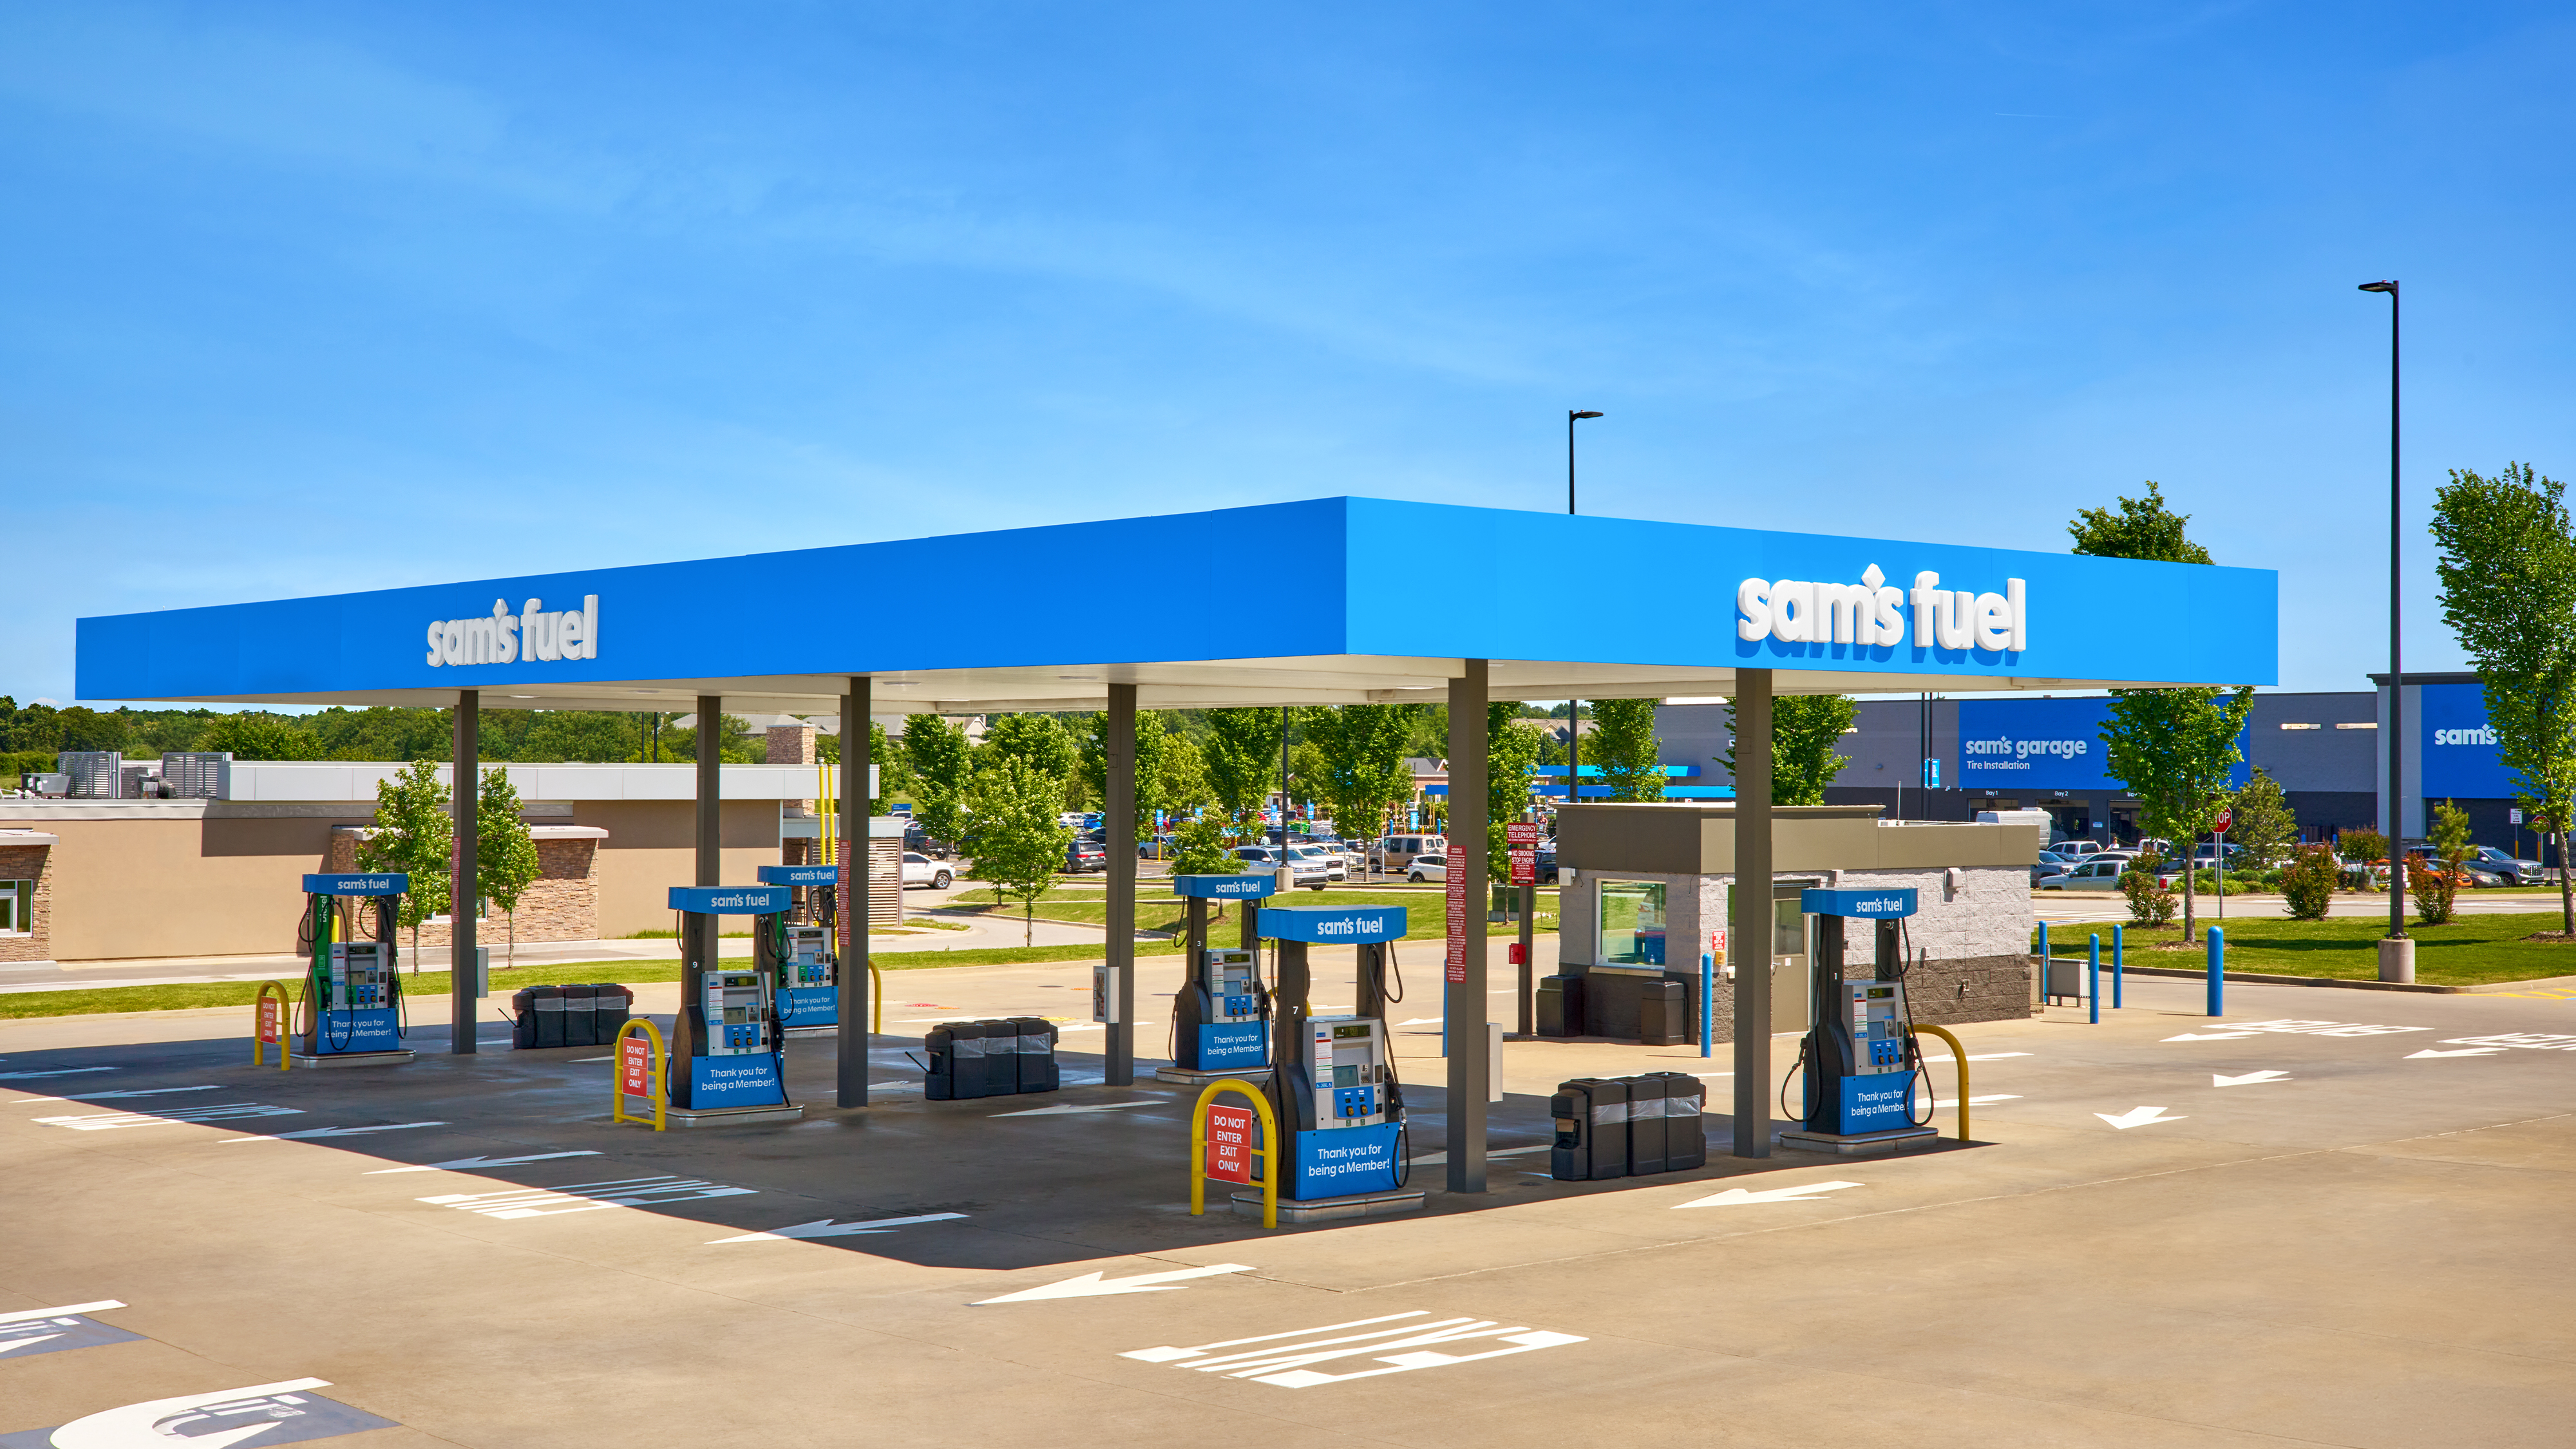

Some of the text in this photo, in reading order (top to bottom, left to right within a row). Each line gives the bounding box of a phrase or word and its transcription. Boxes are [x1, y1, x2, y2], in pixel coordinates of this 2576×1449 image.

[1909, 571, 2026, 652] fuel
[520, 594, 599, 661] fuel
[2016, 740, 2087, 759] garage
[1967, 761, 2030, 770] Tire Installation
[817, 869, 835, 880] fuel
[368, 878, 389, 889] fuel
[1242, 881, 1260, 893] fuel
[746, 893, 769, 906] fuel
[1884, 898, 1902, 911] fuel
[1356, 916, 1383, 933] fuel
[264, 1011, 274, 1019] ENTER
[808, 1005, 835, 1013] Member!
[355, 1028, 391, 1037] Member!
[1235, 1037, 1247, 1046] you
[627, 1045, 645, 1056] DO NOT
[1208, 1046, 1227, 1056] being
[1233, 1043, 1263, 1053] Member!
[628, 1057, 643, 1066] ENTER
[630, 1068, 640, 1077] EXIT
[710, 1066, 768, 1079] Thank you for
[629, 1079, 641, 1088] ONLY
[701, 1081, 727, 1092] being
[735, 1077, 775, 1089] Member!
[1858, 1090, 1904, 1103] Thank you for
[1852, 1106, 1871, 1117] being
[1214, 1115, 1245, 1130] DO NOT
[1217, 1130, 1242, 1143] ENTER
[1220, 1145, 1237, 1157] EXIT
[1318, 1144, 1382, 1160] Thank you for
[1218, 1159, 1240, 1172] ONLY
[1309, 1157, 1390, 1177] being a Member!
